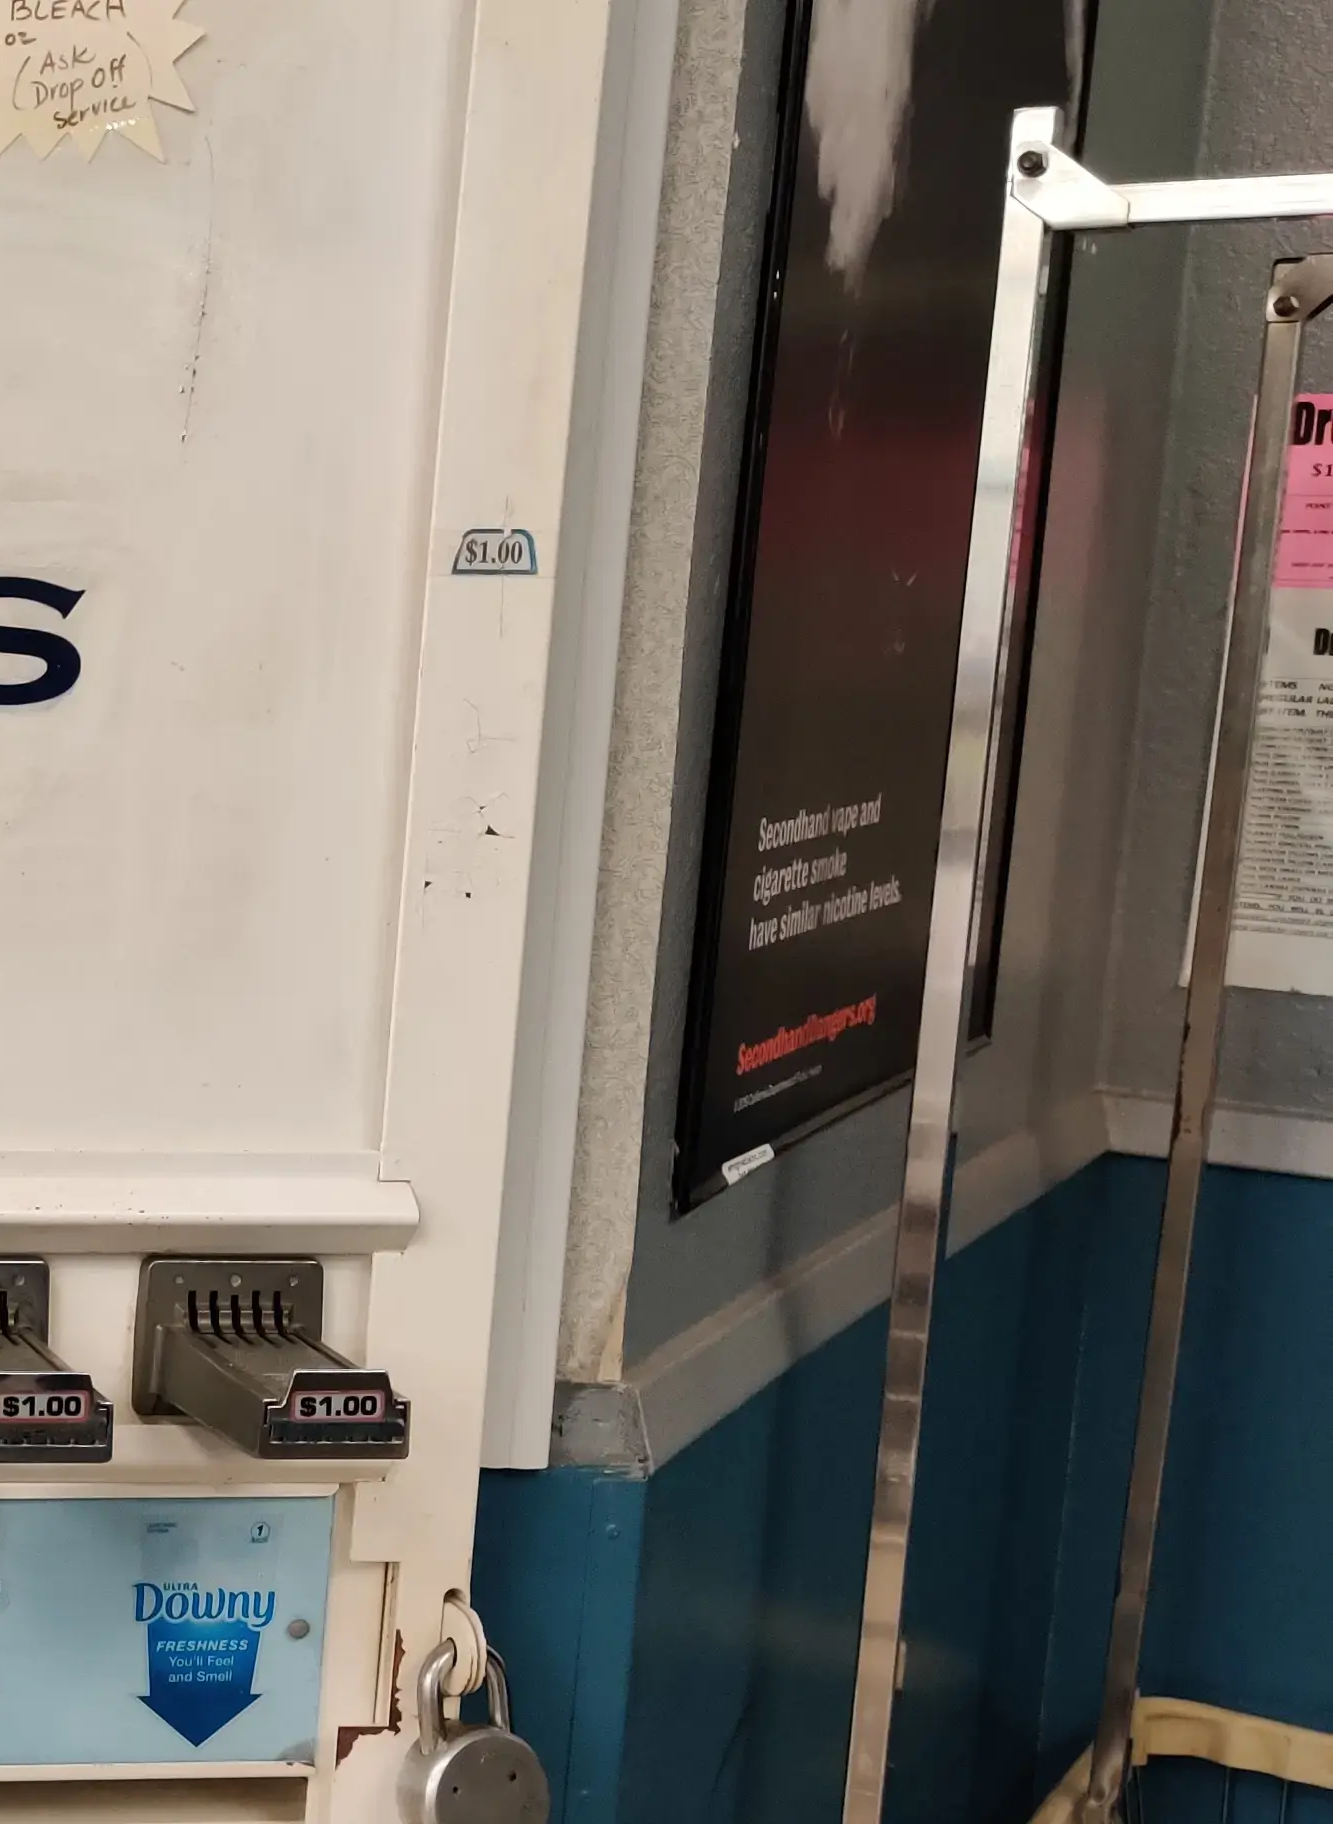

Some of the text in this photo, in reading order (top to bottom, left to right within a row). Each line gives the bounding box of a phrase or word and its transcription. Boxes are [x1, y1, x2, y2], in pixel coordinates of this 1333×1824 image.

[10, 0, 126, 22] BLEACH
[464, 538, 523, 566] $1.00
[758, 804, 831, 852] Secondhand
[859, 792, 882, 827] and
[753, 846, 847, 906] cigarette smoke
[748, 916, 778, 951] have
[779, 900, 822, 941] similar
[823, 885, 868, 925] nicotine
[2, 1395, 82, 1418] $1.00
[299, 1395, 378, 1418] $1.00
[132, 1582, 276, 1628] Downy
[155, 1639, 249, 1652] FRESHNESS
[169, 1655, 234, 1667] You'll Feel
[168, 1670, 233, 1683] and Smell
